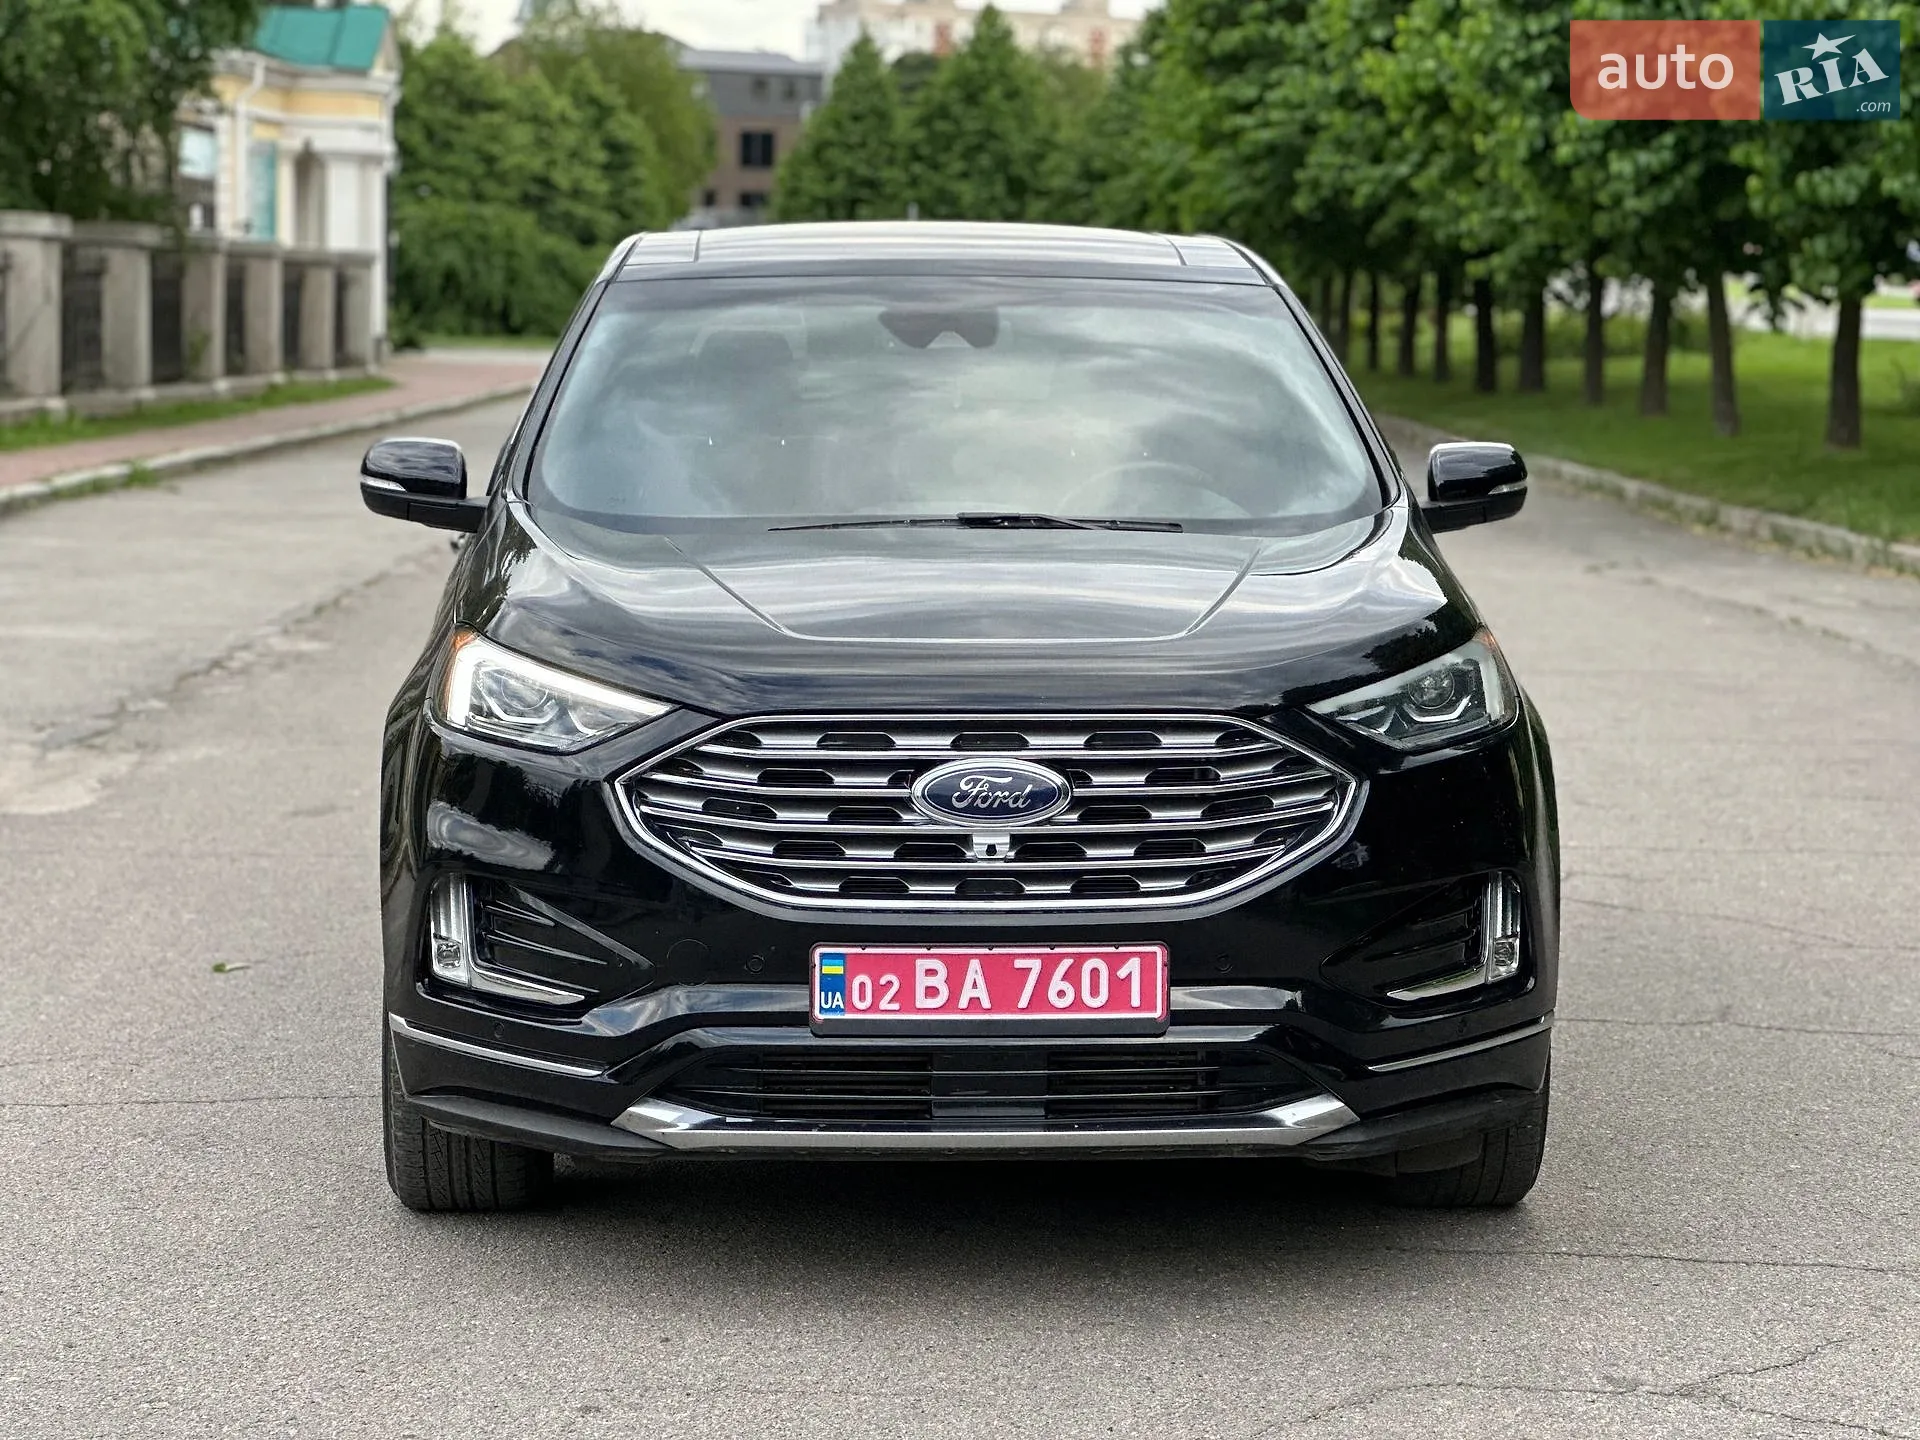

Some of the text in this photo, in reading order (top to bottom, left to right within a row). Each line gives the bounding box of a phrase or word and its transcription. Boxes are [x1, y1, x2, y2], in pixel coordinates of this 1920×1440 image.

[951, 774, 1033, 809] Ford
[820, 991, 845, 1009] UA
[851, 957, 1142, 1011] 02 BA 7601
